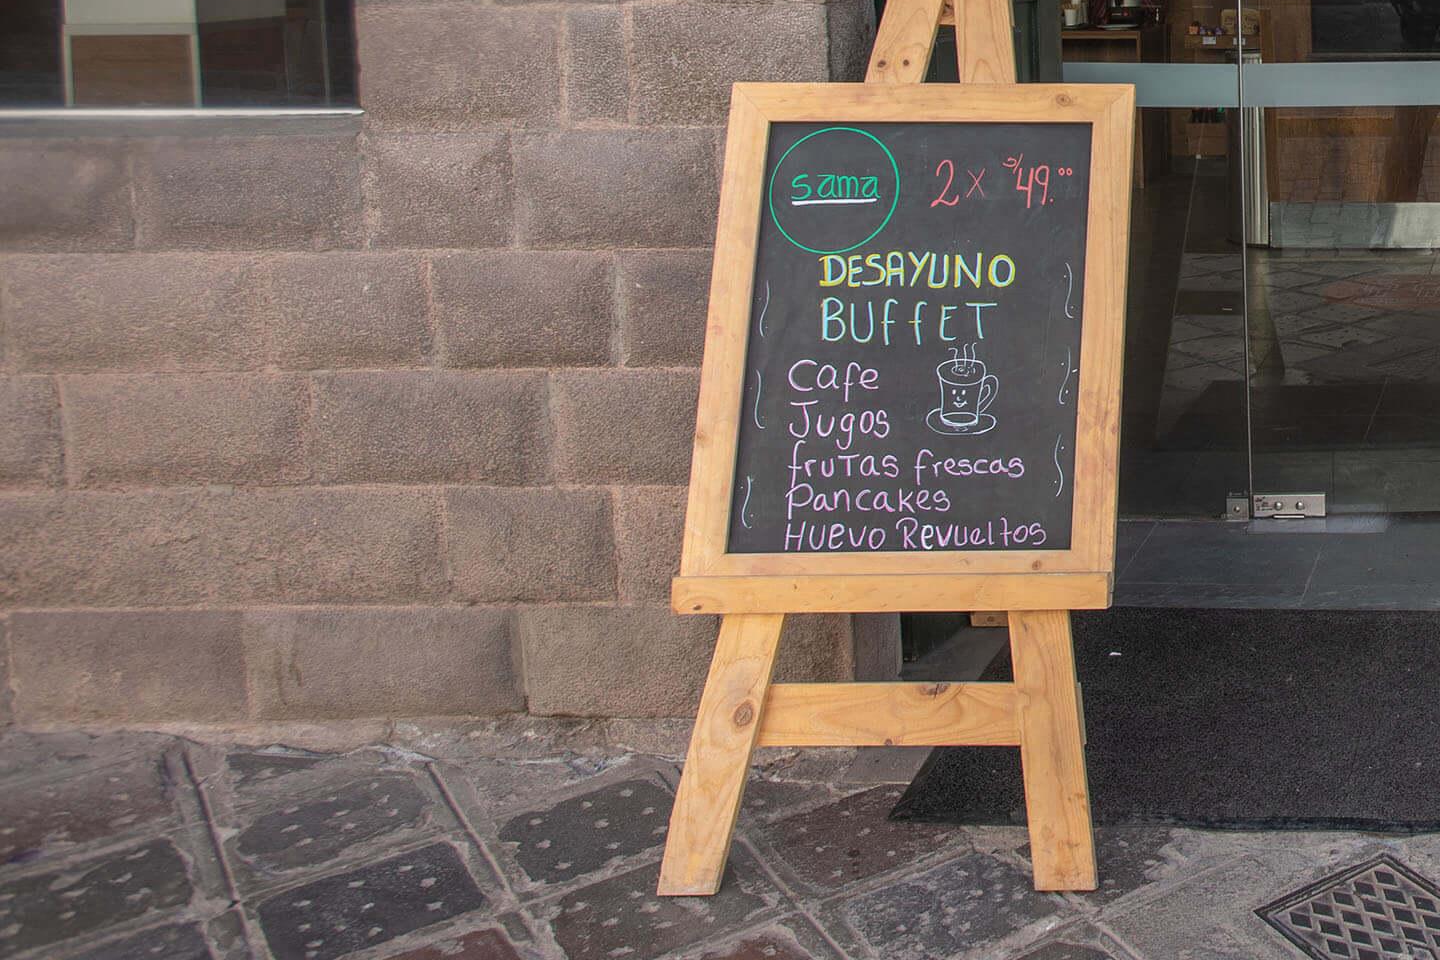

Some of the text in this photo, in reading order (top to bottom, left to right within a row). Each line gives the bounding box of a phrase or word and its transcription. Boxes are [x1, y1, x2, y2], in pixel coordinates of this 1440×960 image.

[791, 173, 881, 200] sama
[930, 159, 960, 208] 2
[818, 251, 1016, 289] DESAYUNO
[788, 359, 879, 402] Cafe
[789, 400, 890, 450] Jugos
[914, 449, 1025, 486] frescas
[785, 483, 951, 520] Pancakes
